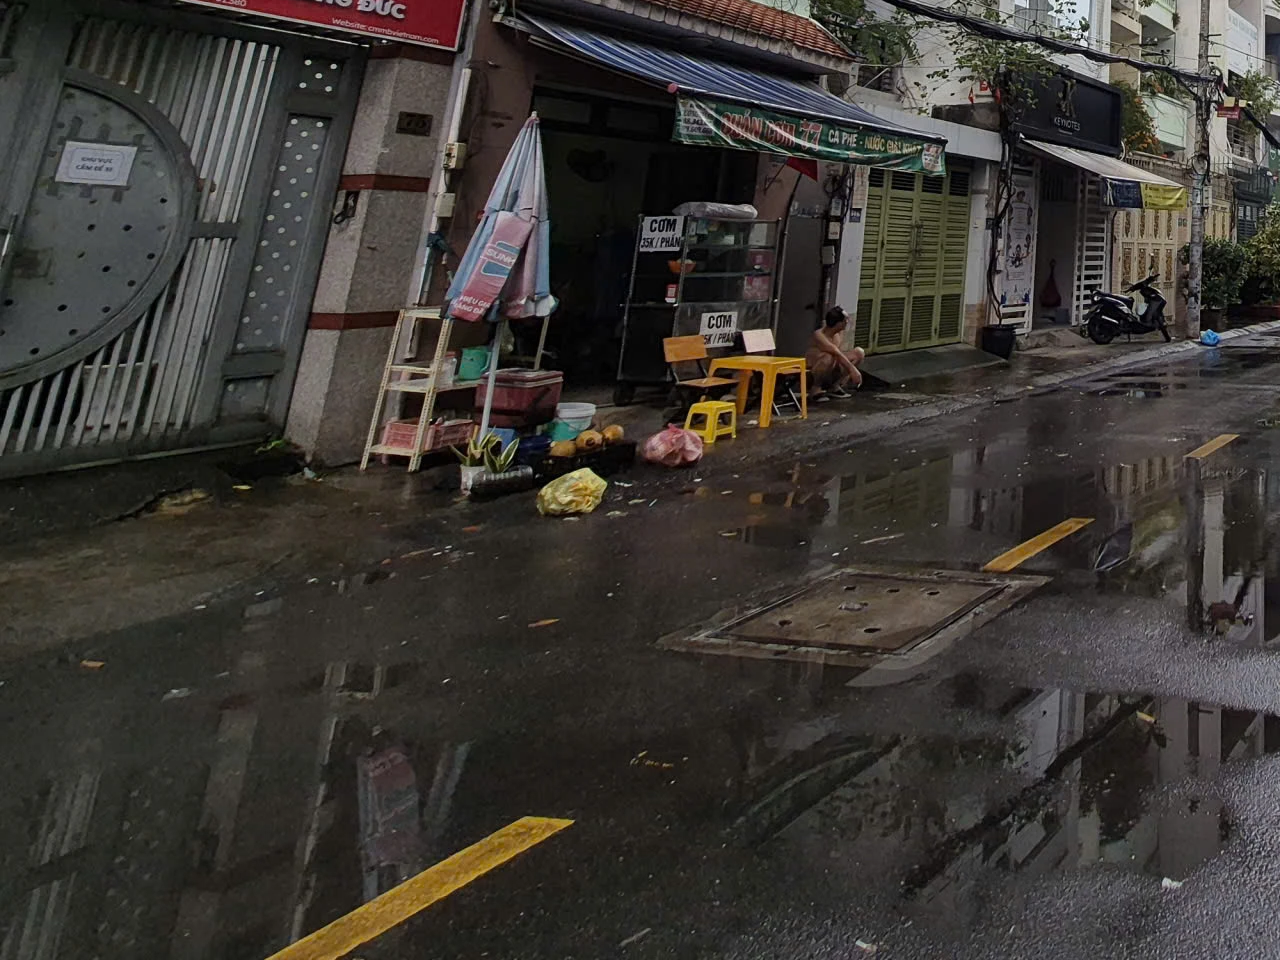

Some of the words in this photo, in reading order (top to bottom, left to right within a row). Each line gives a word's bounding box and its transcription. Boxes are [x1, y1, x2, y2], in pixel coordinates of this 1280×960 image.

[332, 17, 366, 31] Website:
[799, 119, 822, 151] 77
[649, 217, 677, 233] CƠM
[707, 314, 732, 329] CƠM
[703, 333, 713, 346] 5K
